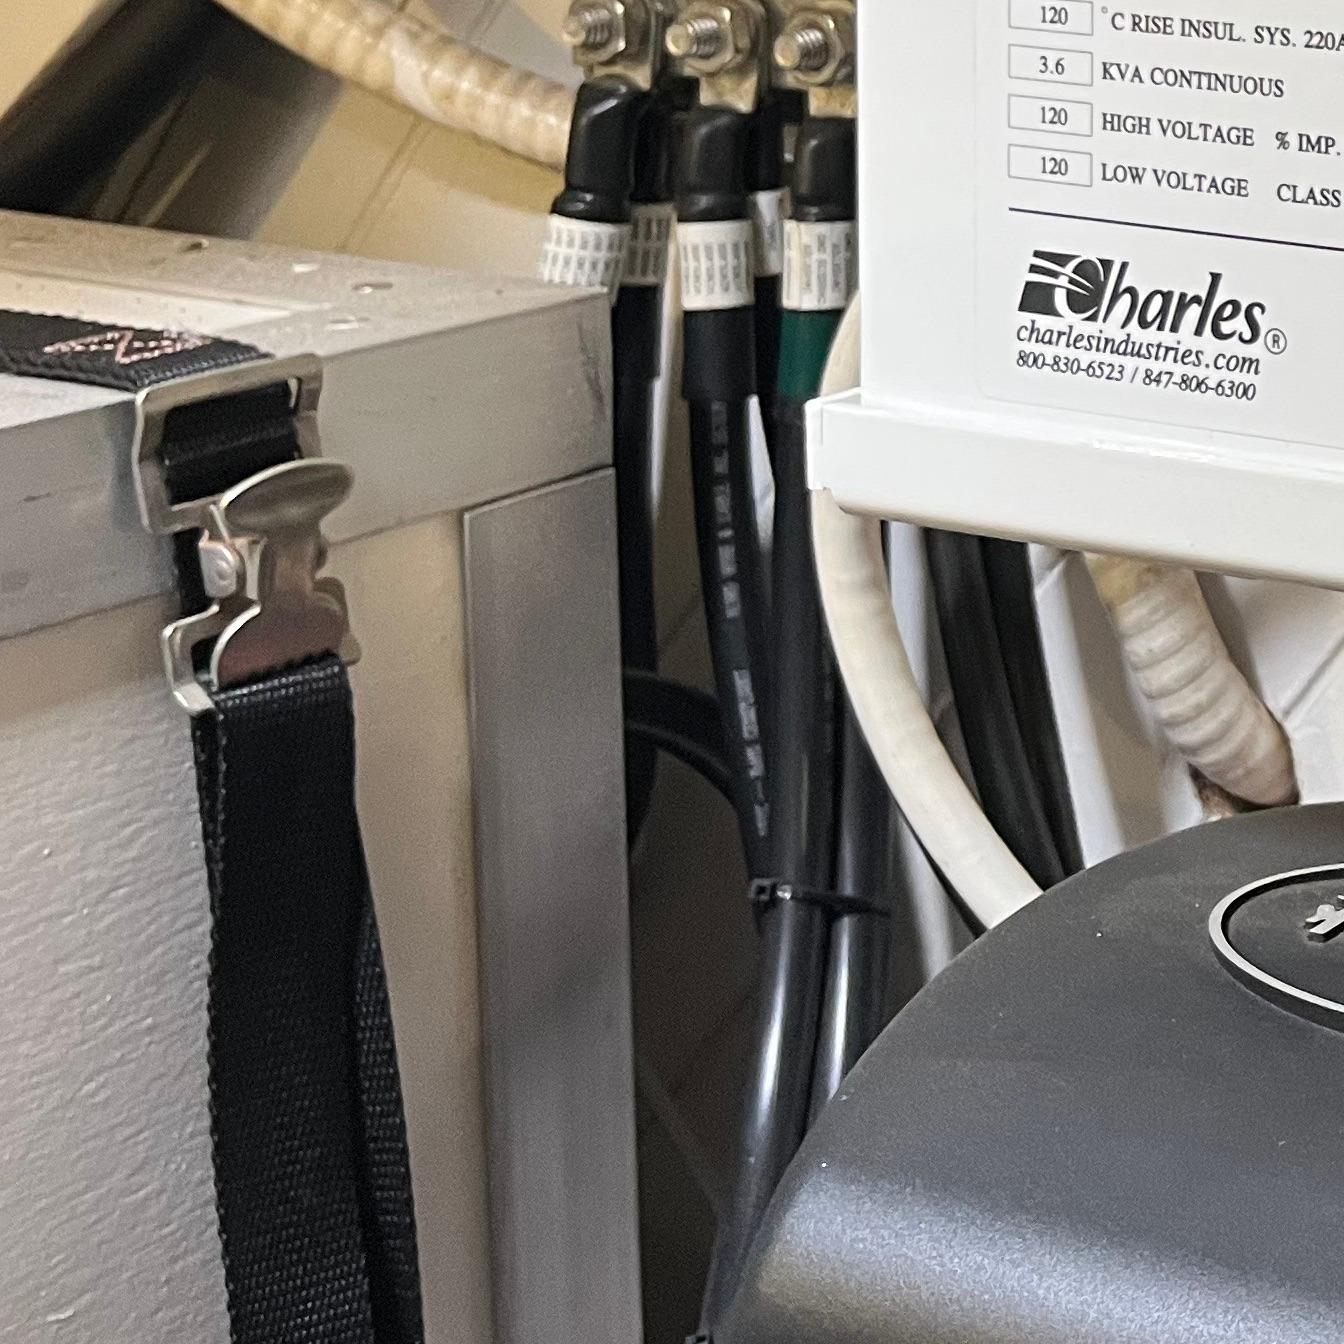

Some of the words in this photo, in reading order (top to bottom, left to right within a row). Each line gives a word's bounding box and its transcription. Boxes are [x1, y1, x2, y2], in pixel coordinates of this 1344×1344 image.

[1040, 5, 1069, 26] 120
[1130, 12, 1175, 36] RISE
[1179, 17, 1247, 43] INSUL.
[1253, 24, 1297, 48] SYS.
[1038, 55, 1066, 76] 3.6
[1100, 61, 1145, 85] KVA
[1149, 66, 1285, 99] CONTINUOUS
[1040, 105, 1069, 127] 120
[1101, 111, 1152, 136] HIGH
[1156, 117, 1255, 147] VOLTAGE
[1274, 130, 1291, 151] %
[1297, 132, 1342, 157] IMP.
[1040, 155, 1069, 177] 120
[1100, 162, 1148, 186] LOW
[1151, 167, 1250, 198] VOLTAGE
[1276, 183, 1342, 209] CLASS
[1017, 320, 1261, 374] charlesindustries.com
[1017, 350, 1126, 382] 800-830-6523
[1143, 367, 1256, 401] 847-806-6300
